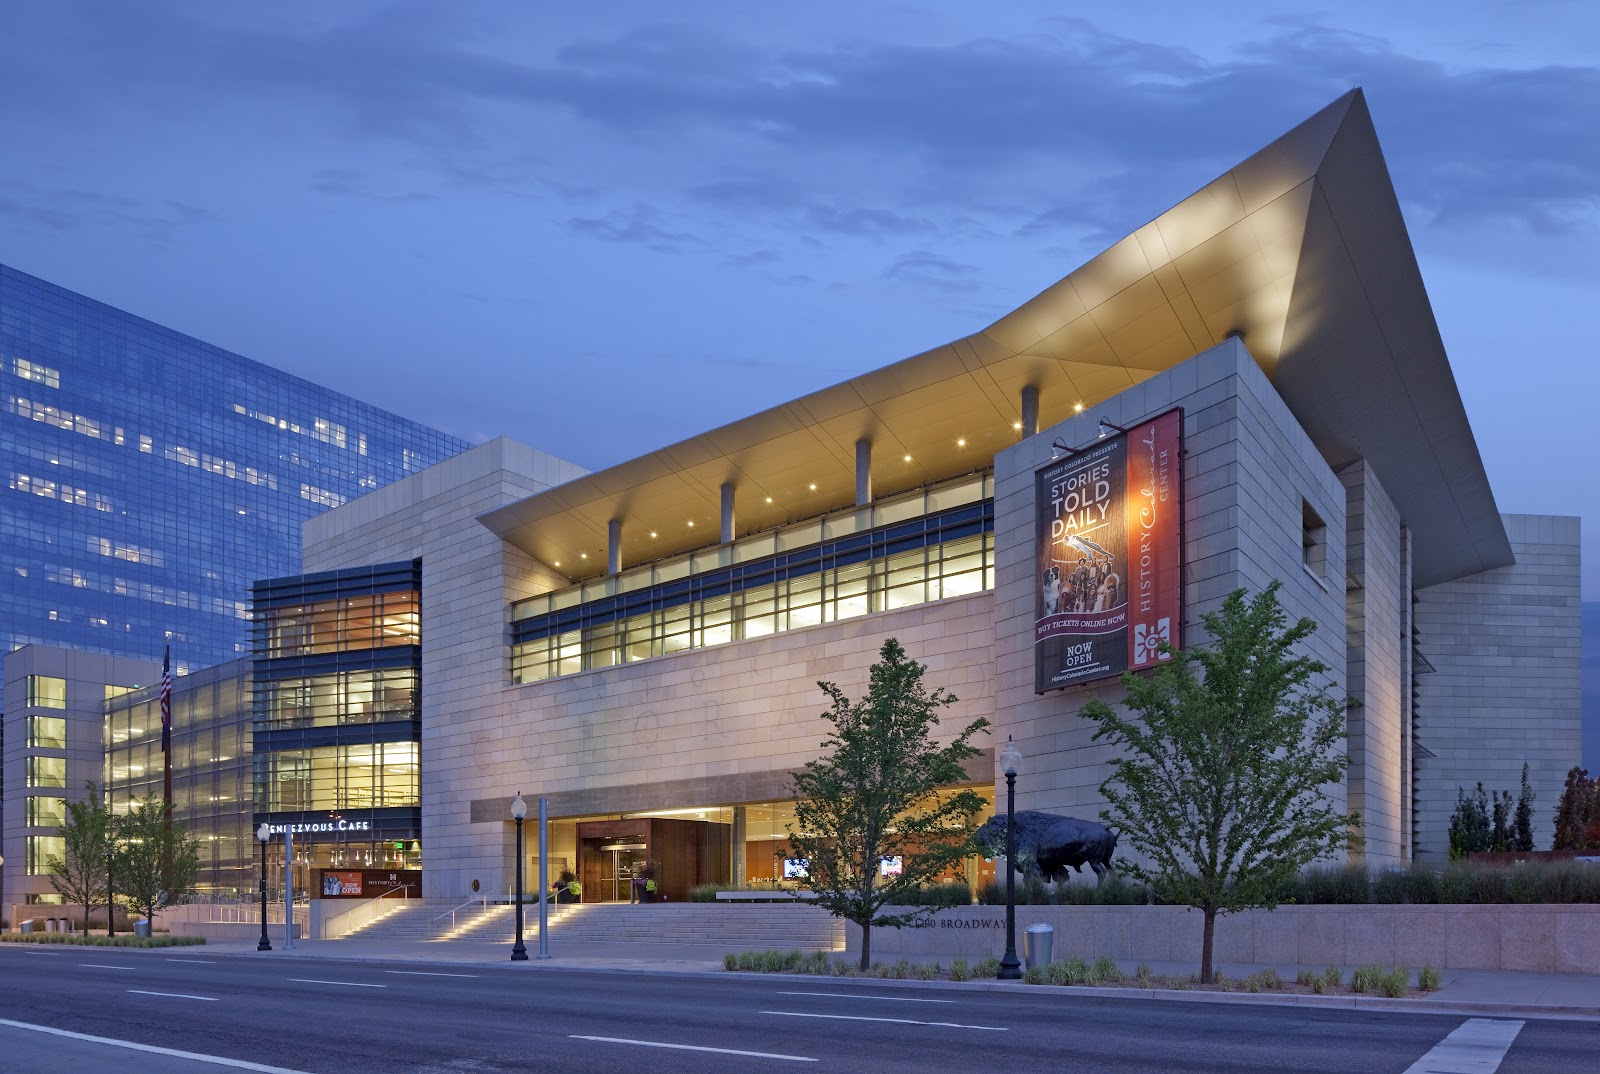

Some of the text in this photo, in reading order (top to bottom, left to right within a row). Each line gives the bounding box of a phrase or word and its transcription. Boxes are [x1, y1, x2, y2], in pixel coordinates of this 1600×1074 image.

[1044, 442, 1118, 480] HISTORY COLORADO PRESENTS
[1160, 449, 1168, 502] CENTER
[1052, 463, 1110, 498] STORIES
[1052, 480, 1110, 518] TOLD
[1052, 498, 1110, 538] DAILY
[1140, 426, 1156, 612] HISTORY Colorado
[1038, 613, 1126, 634] BUY TICKETS ONLINE NOW
[1067, 642, 1092, 657] NOW
[1067, 652, 1092, 666] OPEN
[941, 920, 1007, 928] BROADWAY
